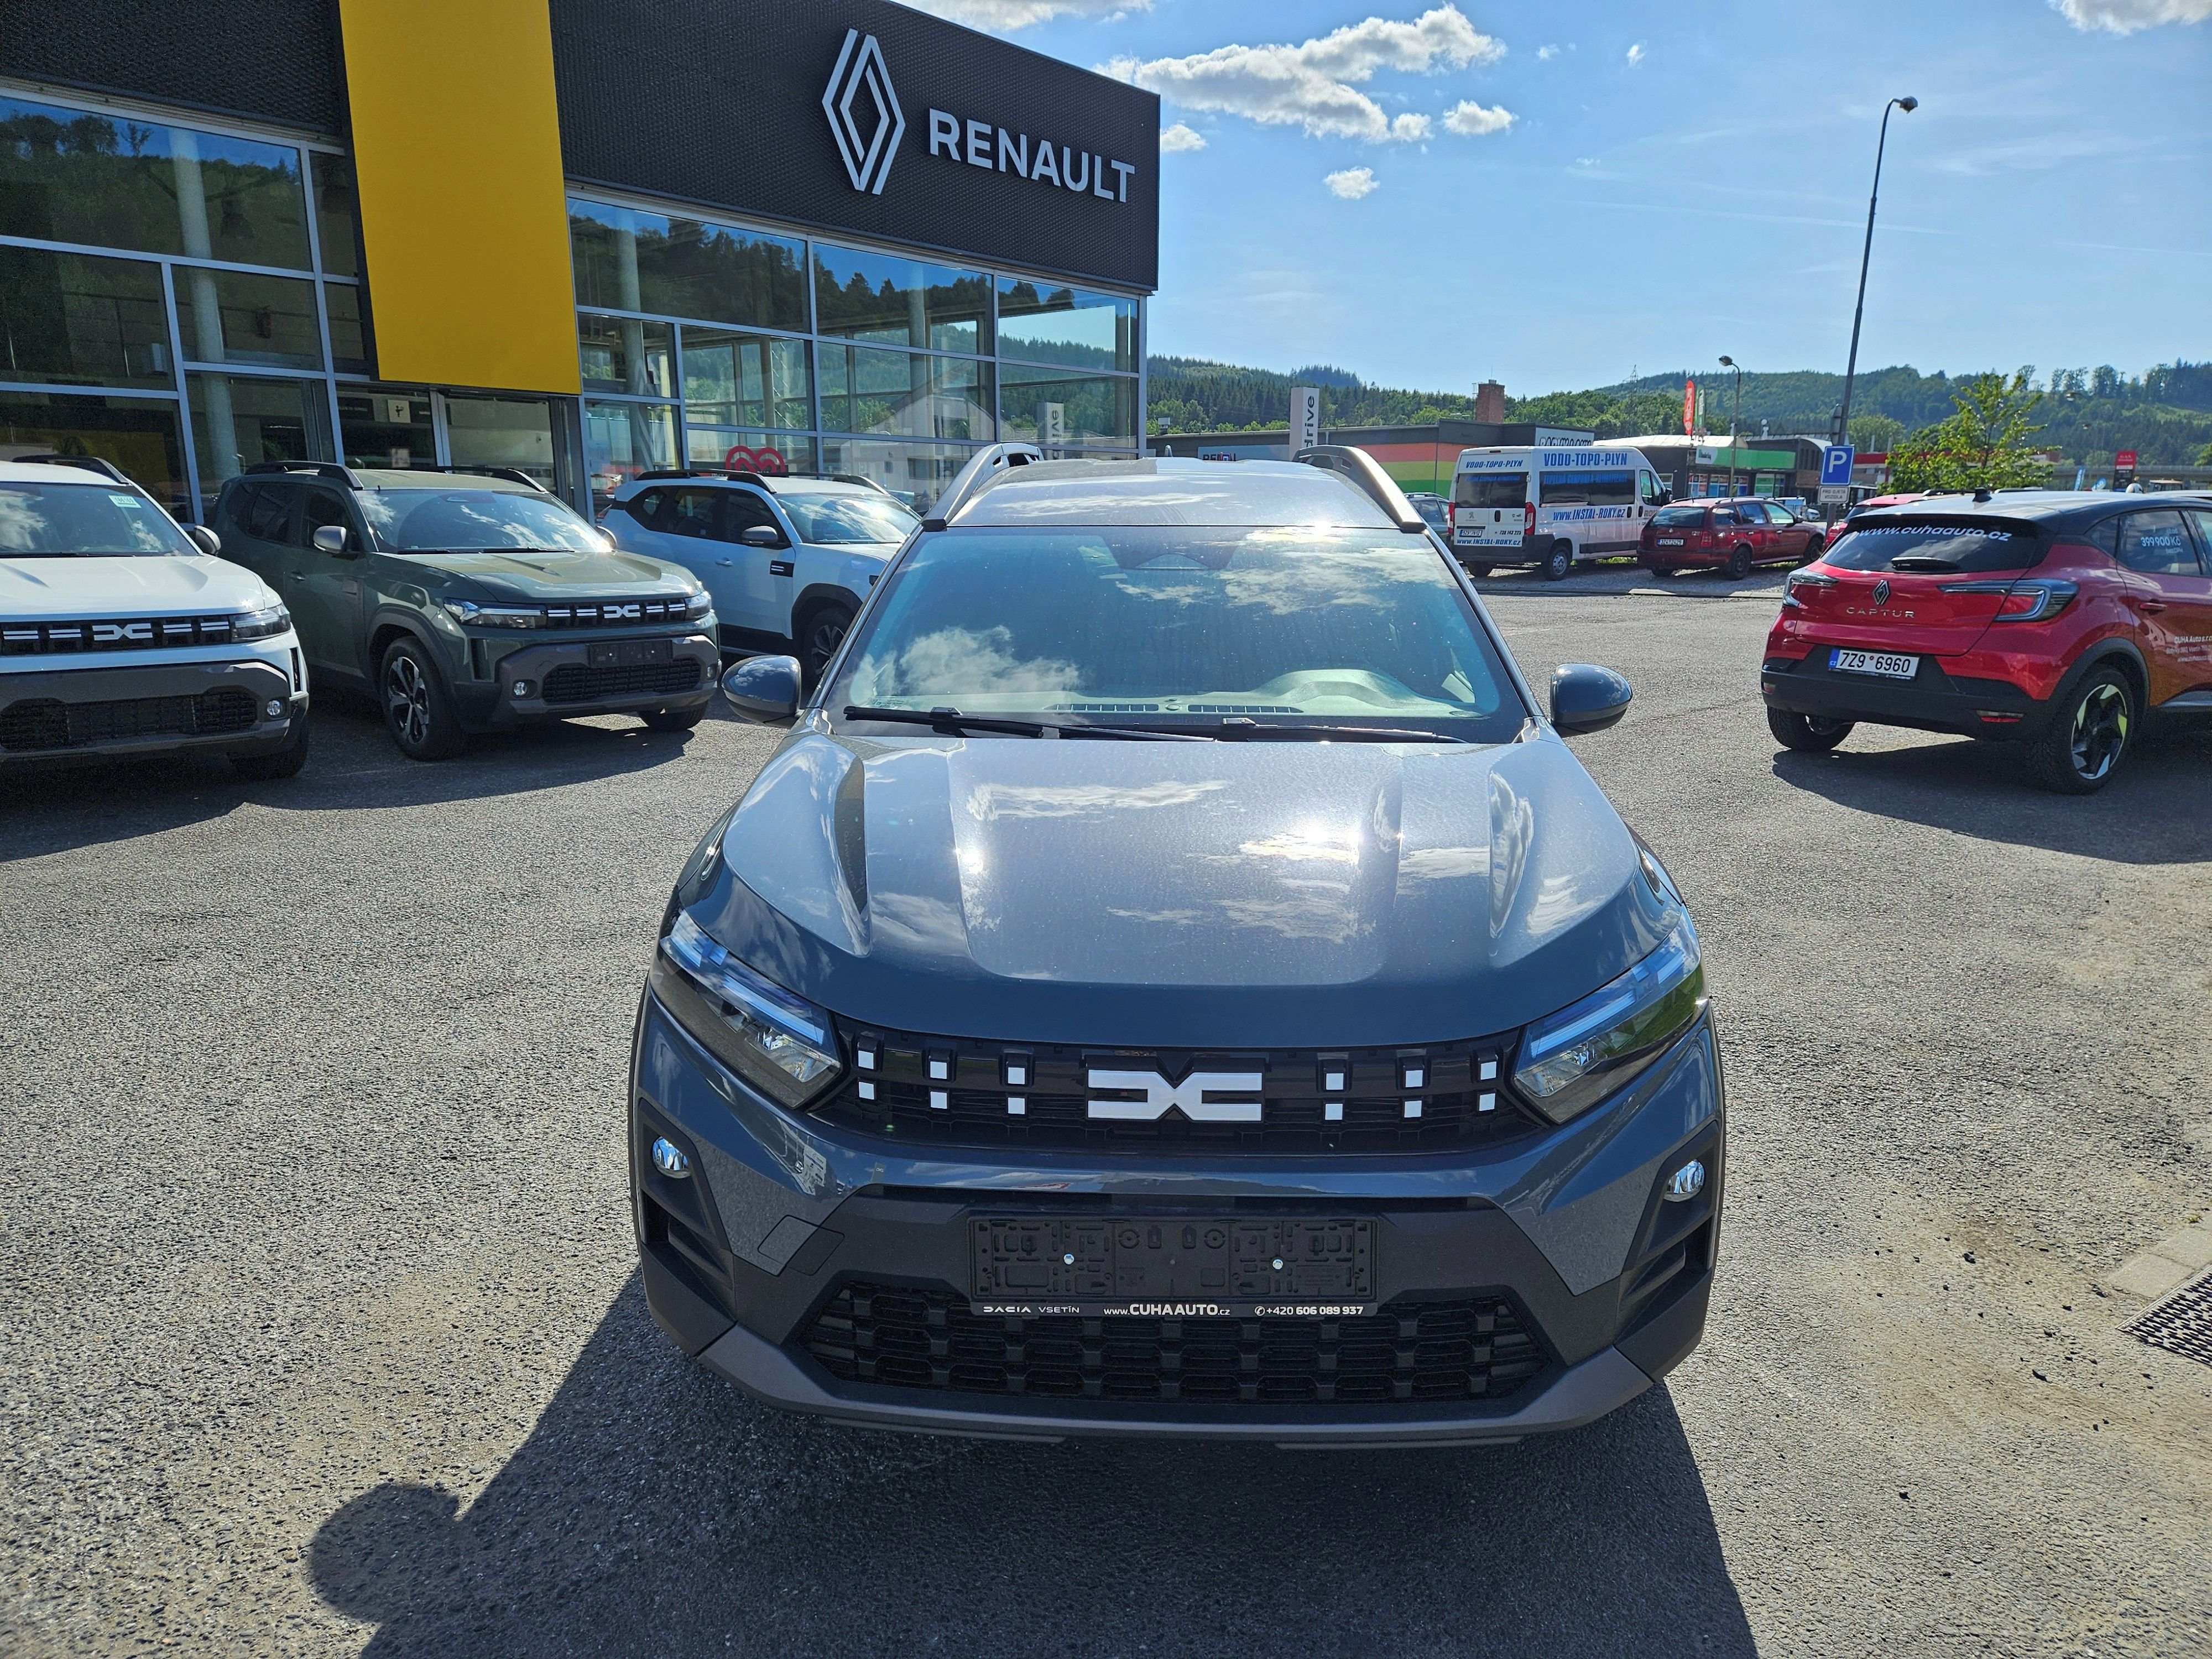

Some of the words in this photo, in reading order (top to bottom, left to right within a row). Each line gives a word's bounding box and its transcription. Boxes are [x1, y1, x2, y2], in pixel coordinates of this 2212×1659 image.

[929, 108, 1135, 202] RENAULT
[1305, 395, 1315, 447] drive
[1465, 460, 1523, 469] VODO-TOPO-PLYN
[1544, 452, 1627, 466] VODO-TOPO-PLYN
[1828, 451, 1846, 473] P
[1859, 525, 2012, 541] www.cuhaauto.cz
[1846, 607, 1914, 618] CAPTUR
[1840, 652, 1866, 668] 7Z9
[1875, 656, 1911, 673] 6960
[1103, 1304, 1230, 1316] www.CUHAAUTO.cz
[1266, 1306, 1293, 1315] +420
[1296, 1306, 1317, 1315] 606
[1319, 1306, 1340, 1315] 089
[1342, 1306, 1364, 1315] 937
